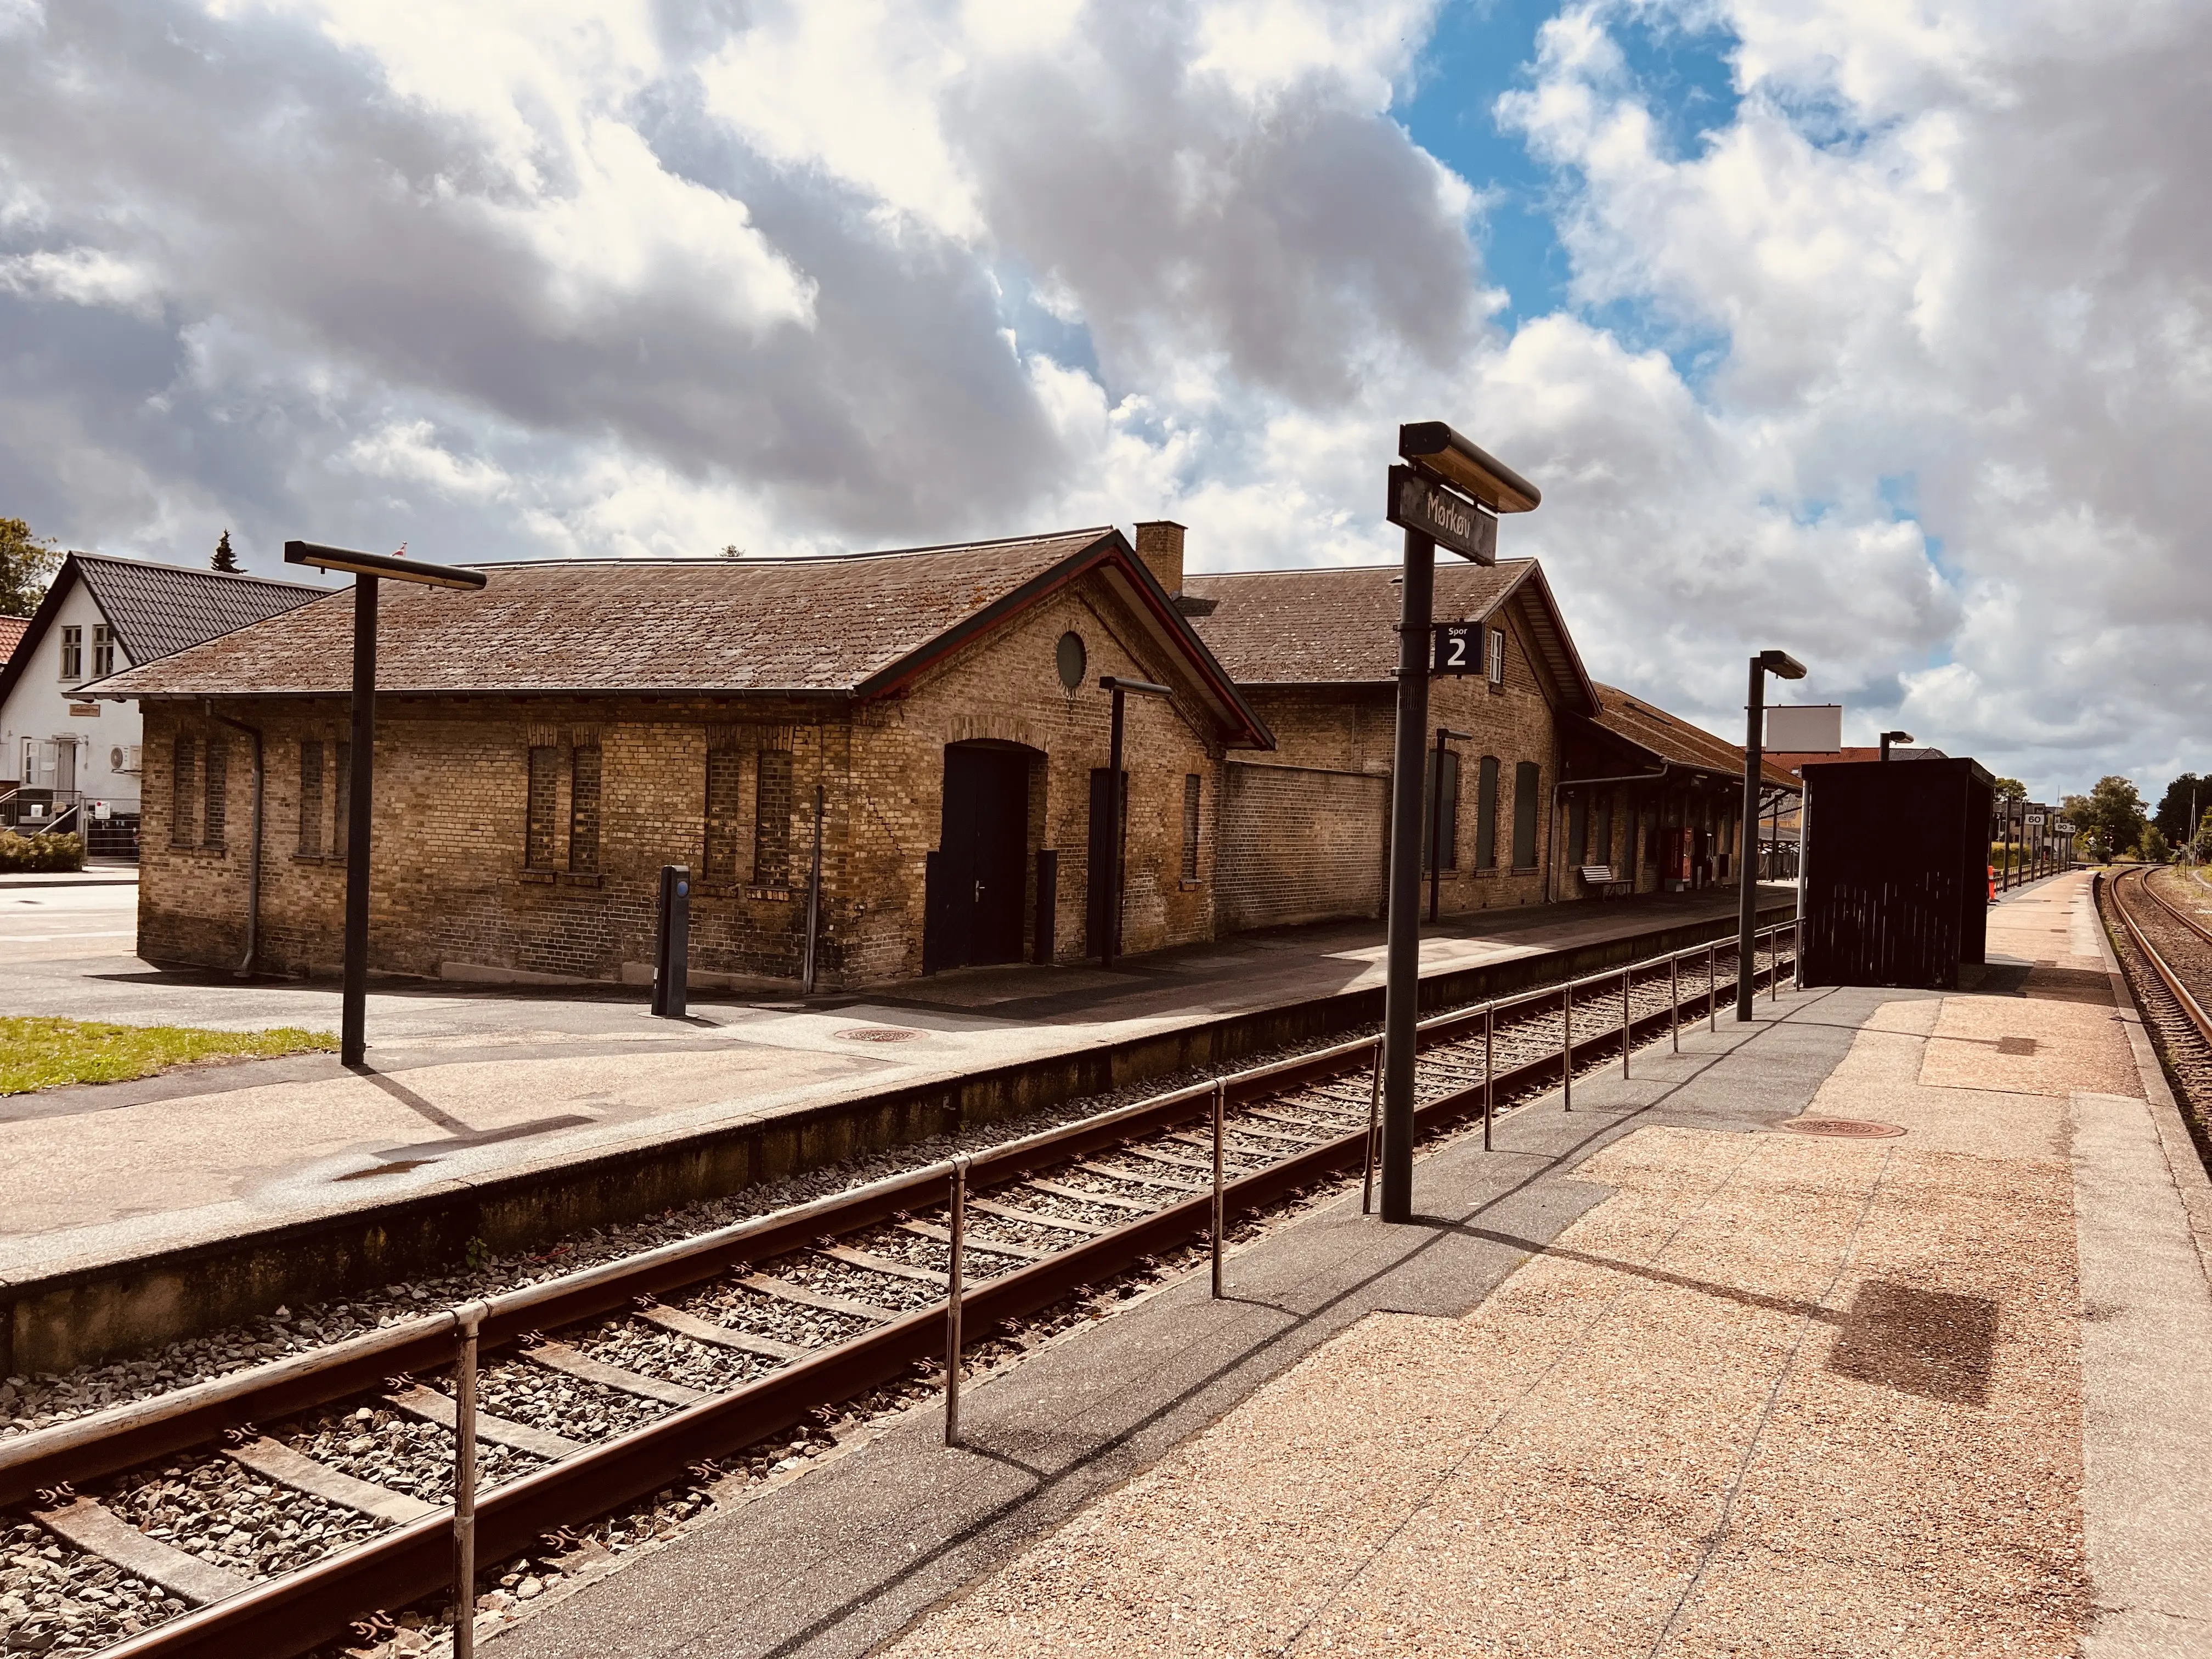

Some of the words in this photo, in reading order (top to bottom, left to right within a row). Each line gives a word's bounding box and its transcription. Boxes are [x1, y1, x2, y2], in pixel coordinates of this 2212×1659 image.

[1427, 492, 1470, 539] Mørkøv
[1448, 628, 1468, 636] Spor
[1447, 638, 1466, 666] 2
